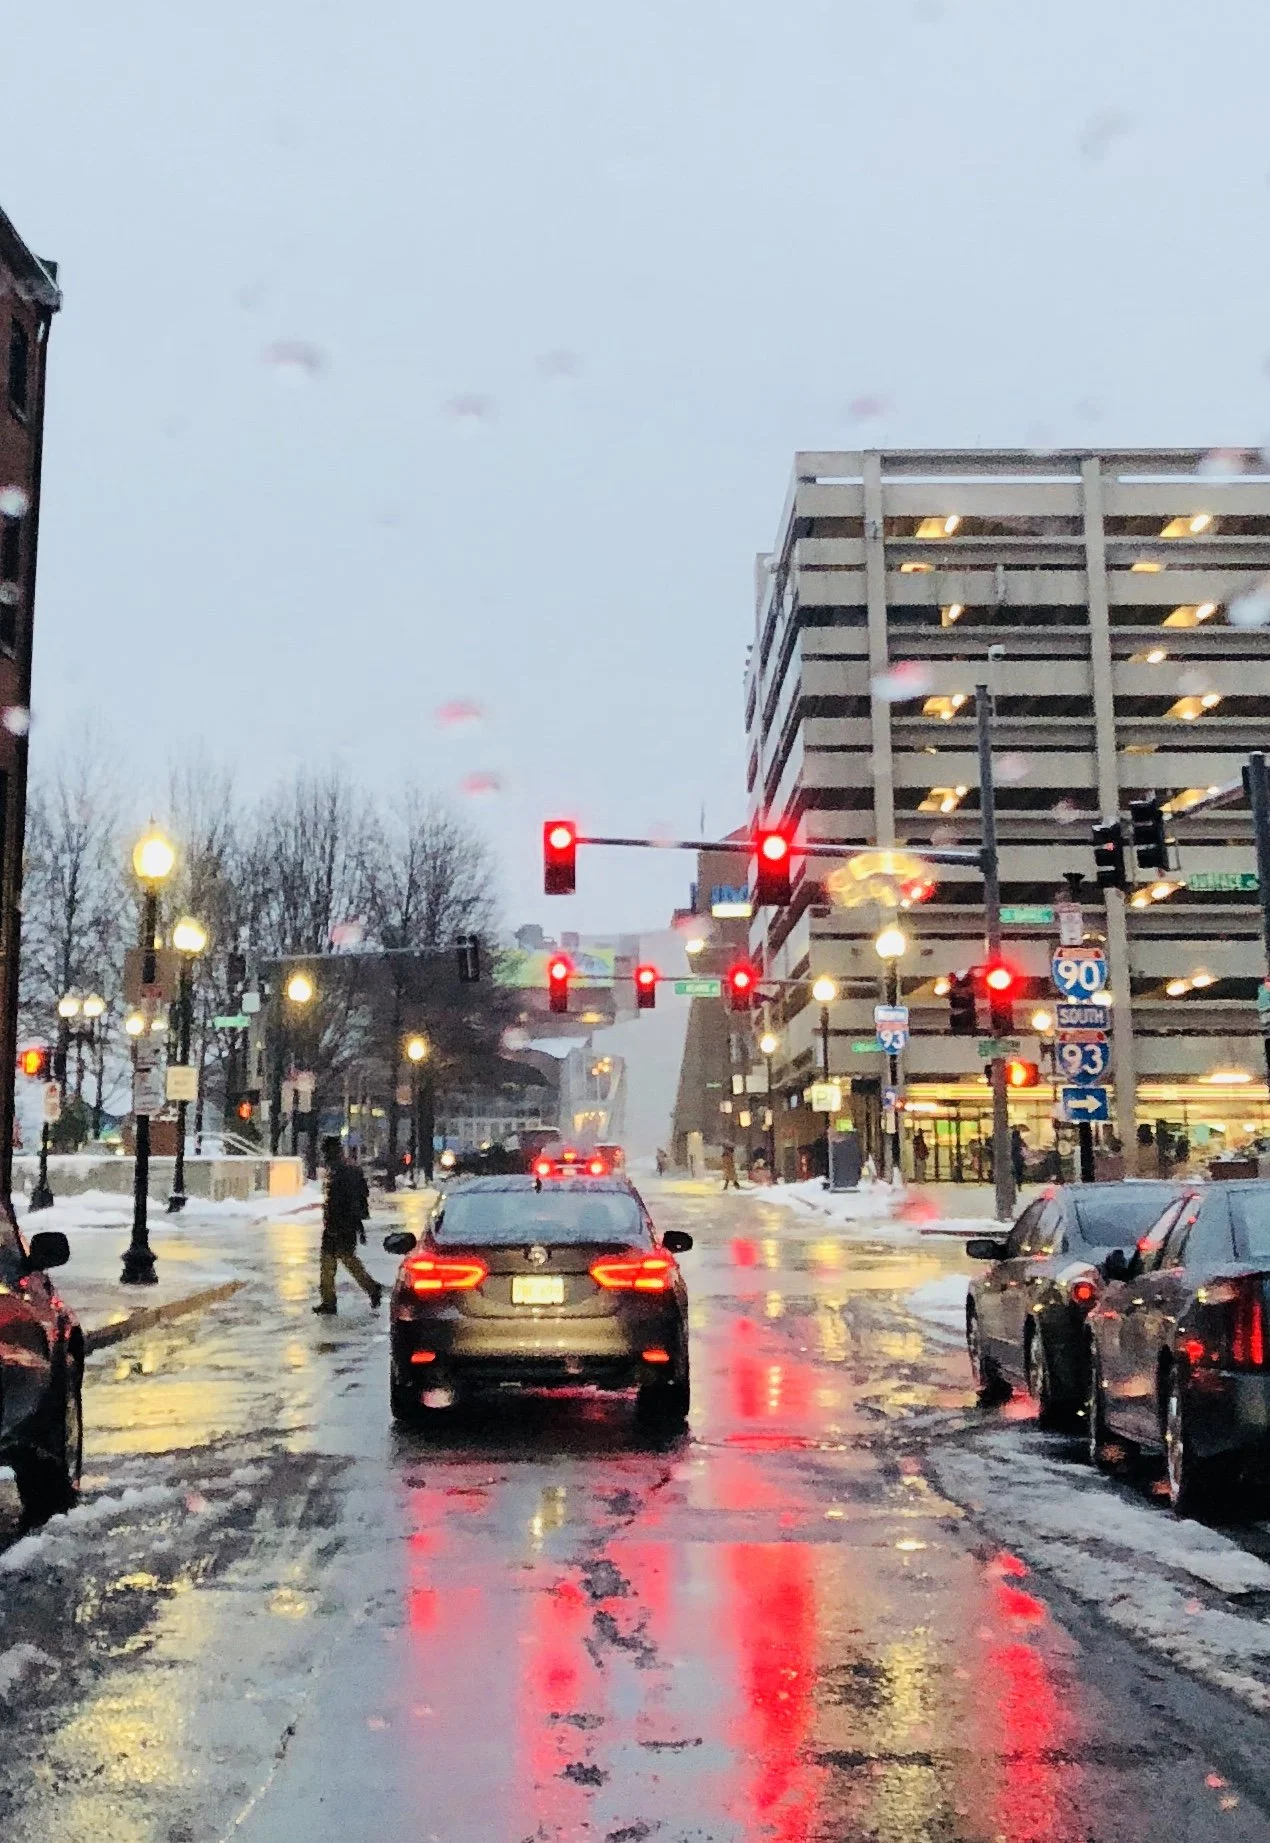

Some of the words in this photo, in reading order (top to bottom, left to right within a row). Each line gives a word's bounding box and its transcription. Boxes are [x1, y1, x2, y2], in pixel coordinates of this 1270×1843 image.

[1058, 960, 1100, 991] 90
[1060, 1008, 1105, 1025] SOUTH
[881, 1030, 905, 1049] 93
[1062, 1043, 1104, 1075] 93
